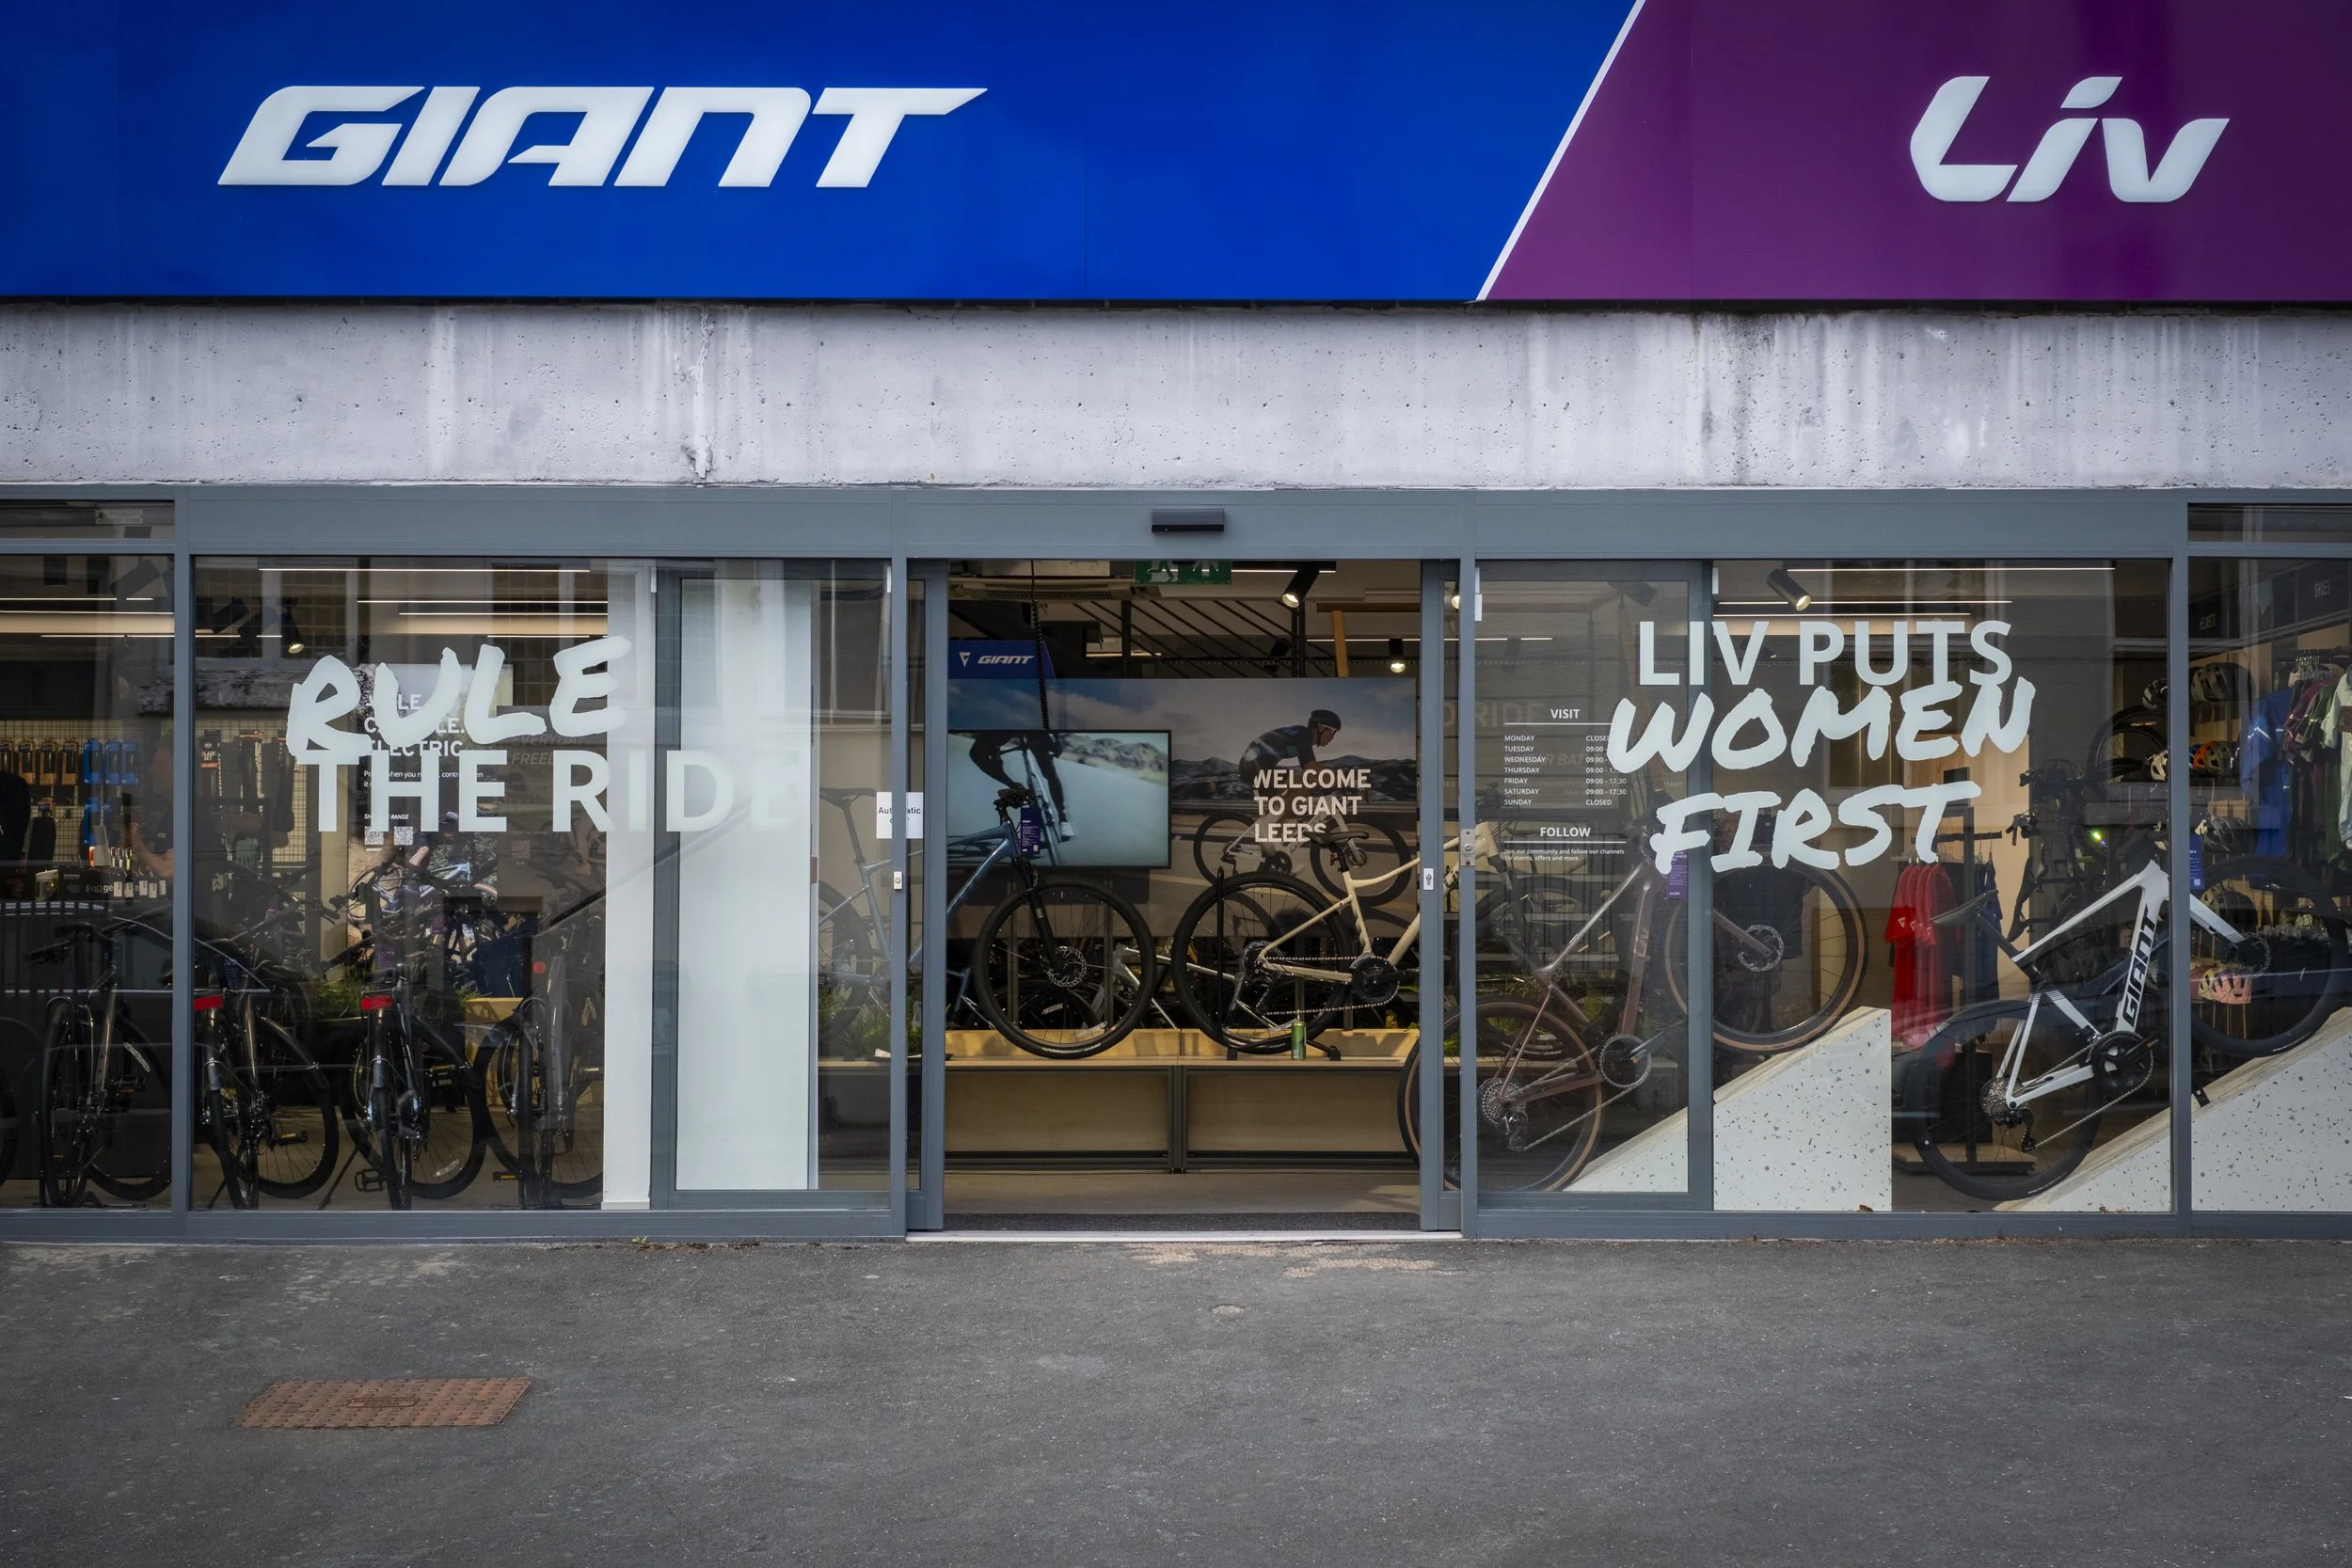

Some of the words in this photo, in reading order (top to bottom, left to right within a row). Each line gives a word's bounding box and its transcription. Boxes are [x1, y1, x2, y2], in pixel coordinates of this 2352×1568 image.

[217, 85, 988, 187] GIANT
[977, 655, 1035, 664] GIANT
[1639, 621, 1770, 686] LIV
[1799, 620, 2012, 687] PUTS
[285, 636, 632, 758] RULE
[1550, 708, 1581, 719] VISIT
[1606, 676, 2036, 774] WOMEN
[296, 749, 507, 832] THE
[552, 749, 801, 832] RIDE
[1253, 768, 1372, 789] WELCOME
[1253, 796, 1285, 816] TO
[1291, 796, 1362, 816] GIANT
[1540, 827, 1591, 837] FOLLOW
[1649, 781, 1981, 875] FIRST
[2122, 903, 2156, 1028] GIANT
